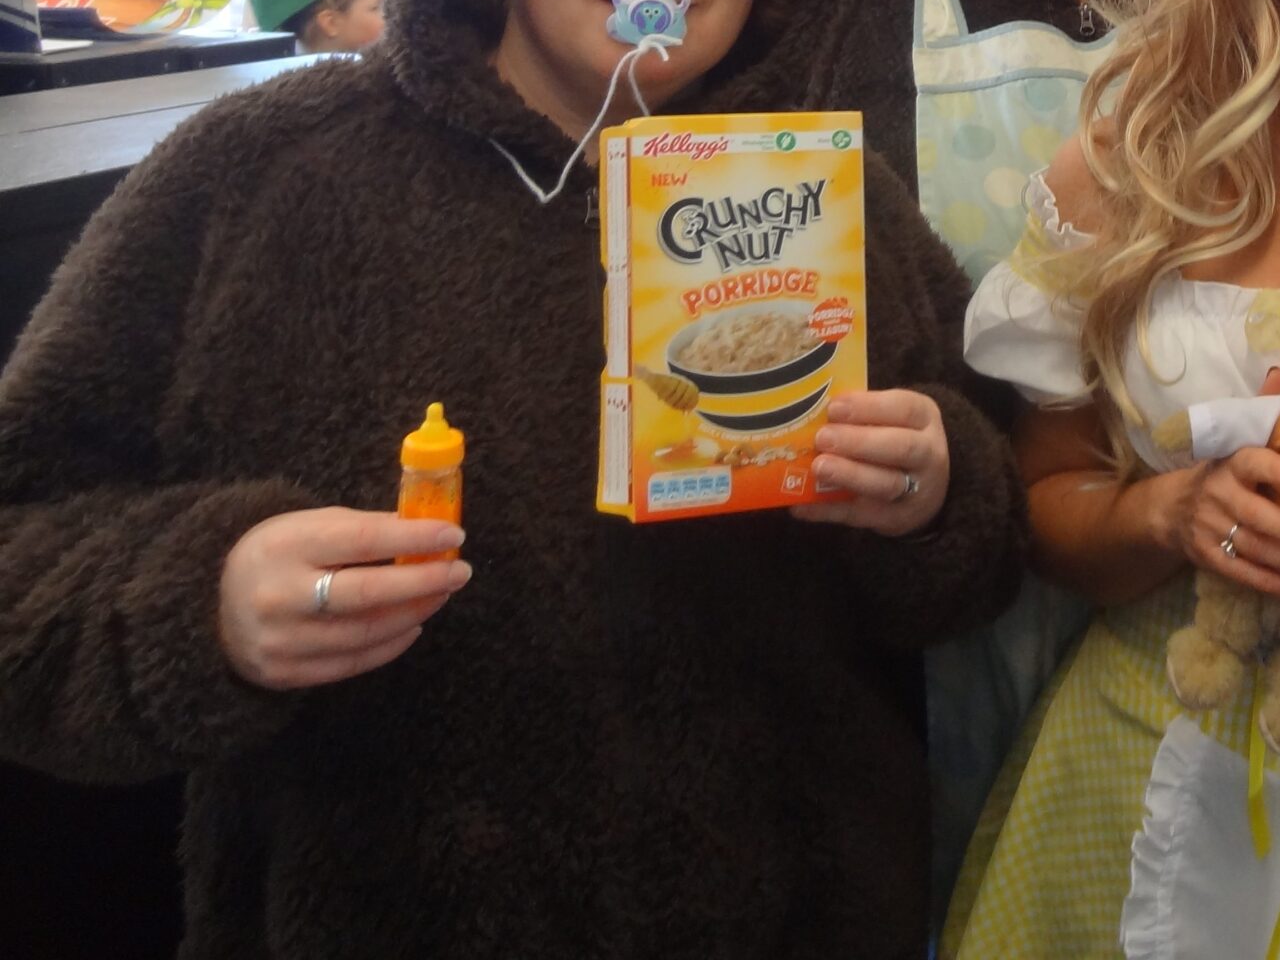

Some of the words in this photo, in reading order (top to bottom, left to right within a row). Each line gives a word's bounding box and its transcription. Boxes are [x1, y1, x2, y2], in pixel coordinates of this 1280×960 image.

[643, 132, 730, 160] Kellogg's
[651, 173, 688, 187] NEW
[658, 179, 827, 262] CRUNCHY
[715, 224, 794, 271] NUT
[681, 269, 819, 315] PORRIDGE
